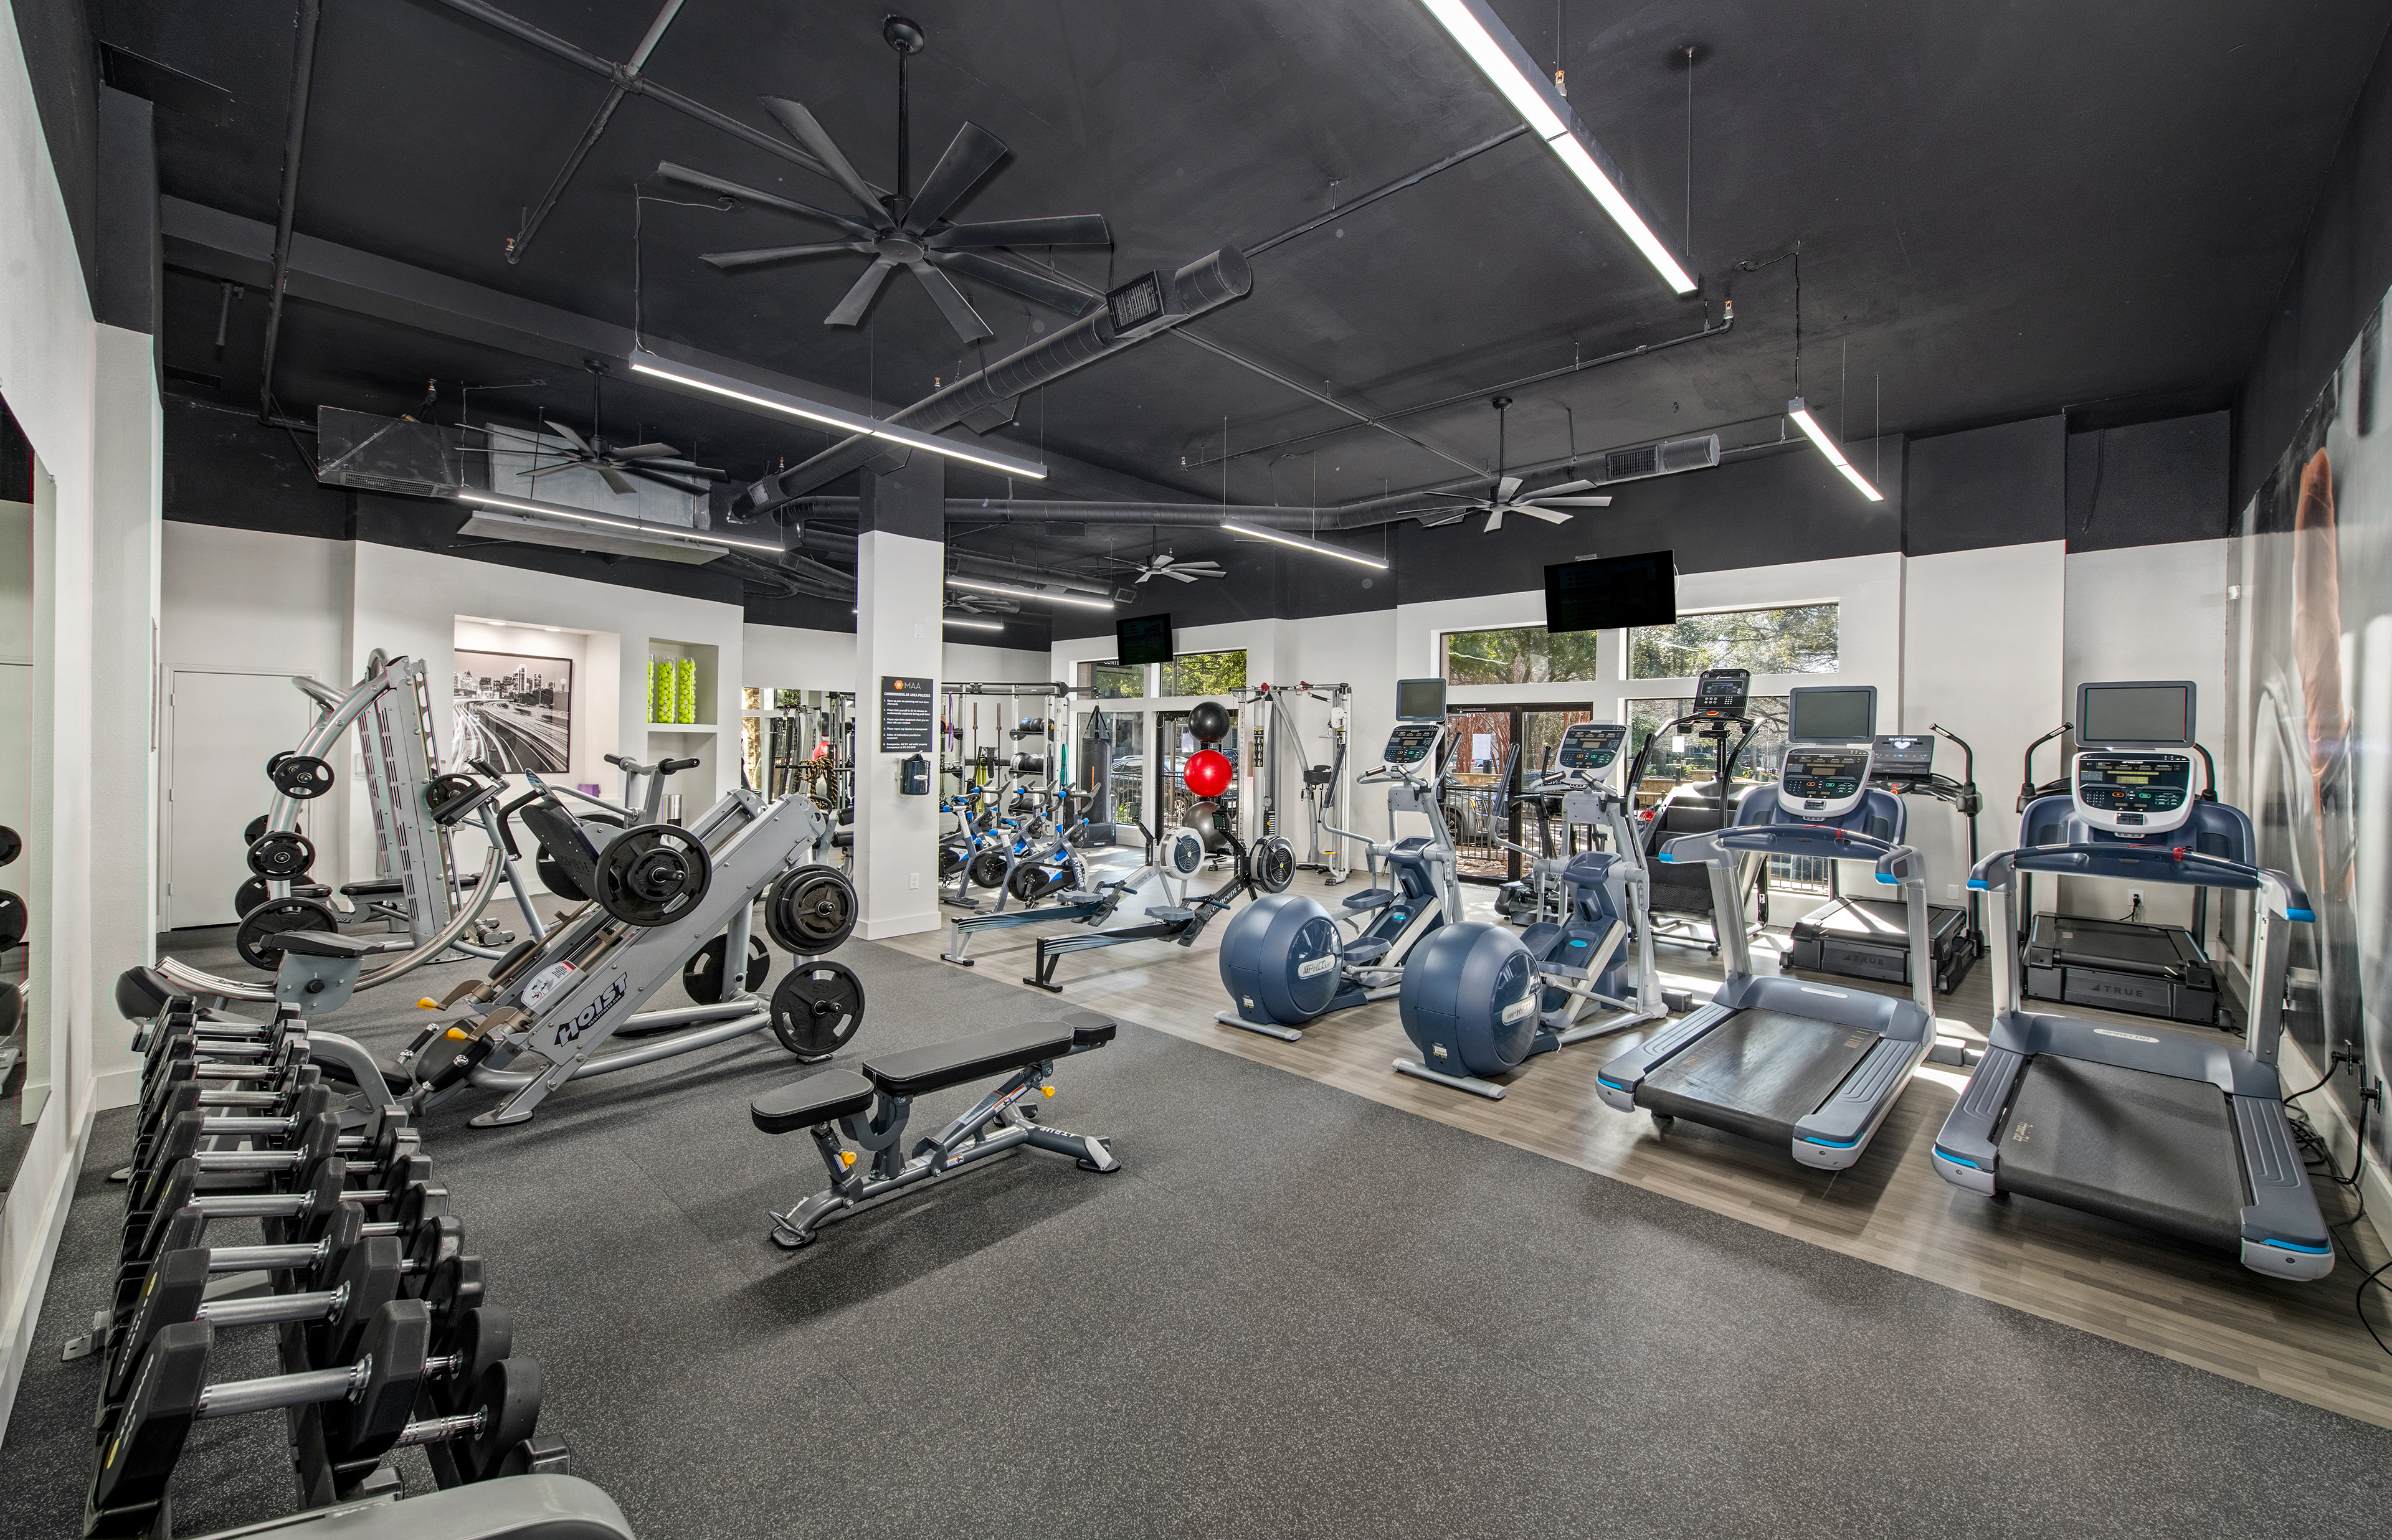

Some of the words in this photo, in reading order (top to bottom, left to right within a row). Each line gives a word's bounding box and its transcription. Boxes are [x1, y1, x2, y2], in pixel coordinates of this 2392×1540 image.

[1072, 857, 1085, 888] STAGES
[1853, 955, 1884, 965] TRUE
[2104, 985, 2143, 998] TRUE
[558, 971, 627, 1047] HOIST
[588, 994, 622, 1026] HOISTFITNESS.COM
[2102, 1030, 2150, 1041] PRECOR
